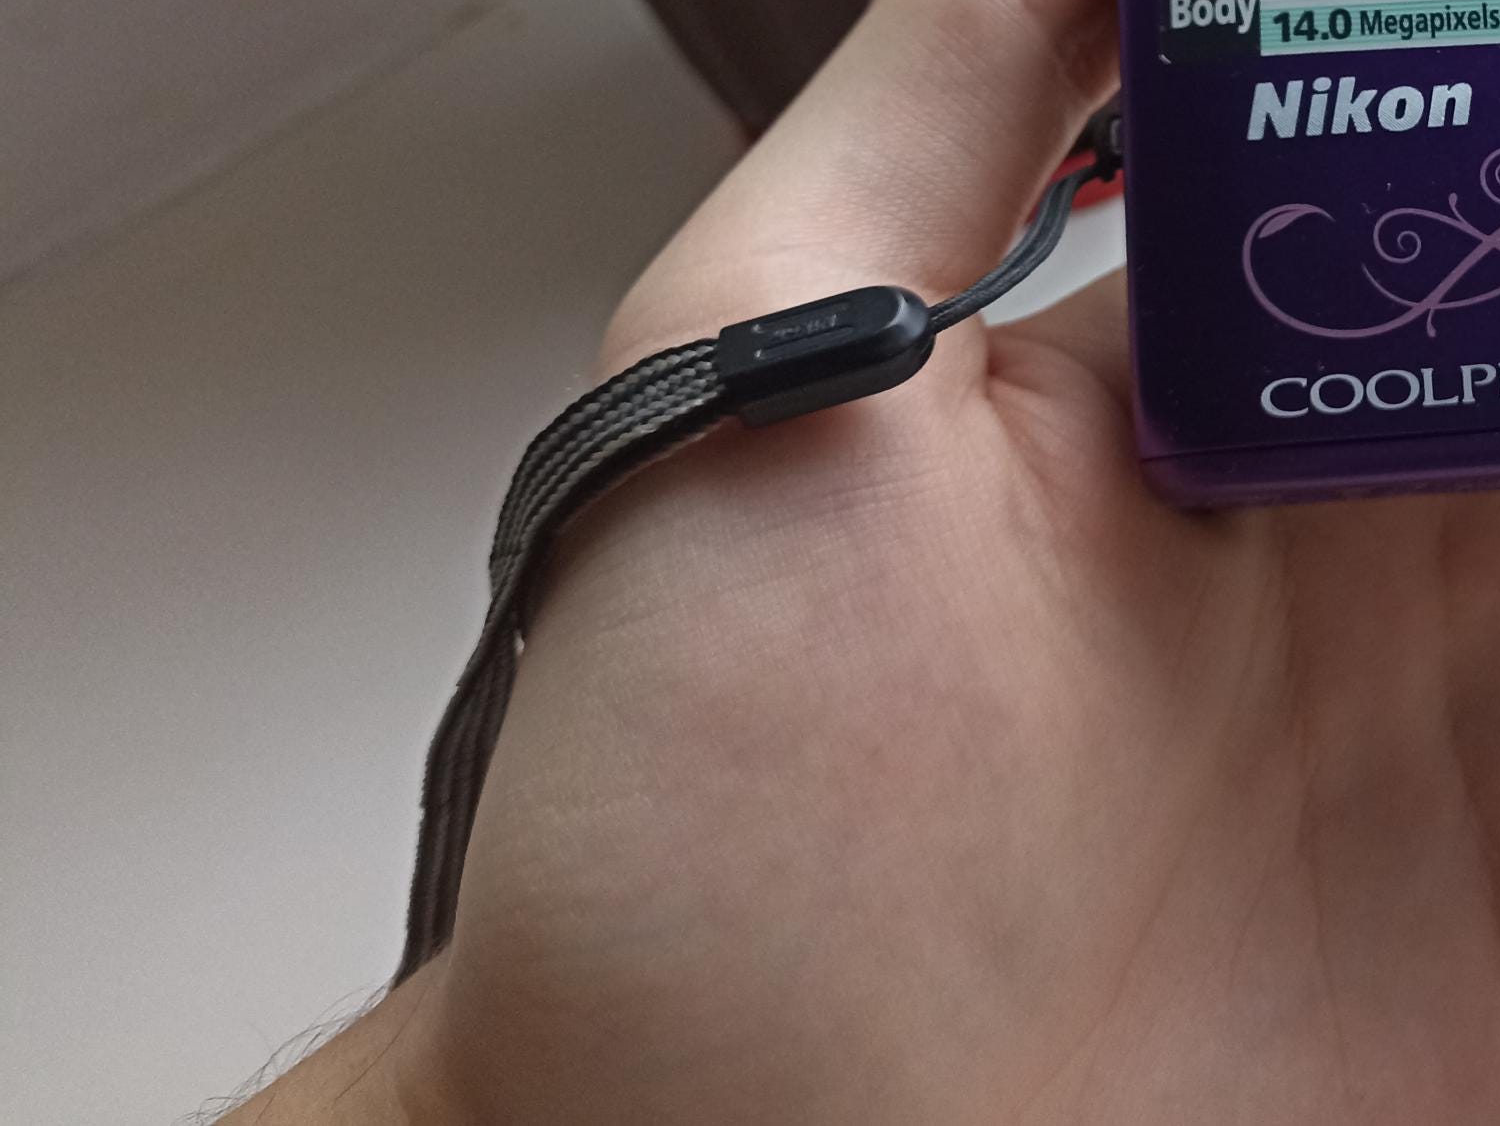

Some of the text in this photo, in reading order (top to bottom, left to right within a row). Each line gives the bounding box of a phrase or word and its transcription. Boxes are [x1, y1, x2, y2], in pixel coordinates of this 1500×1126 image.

[1273, 3, 1500, 43] 14.0 Megapixels
[1247, 76, 1473, 141] Nikon
